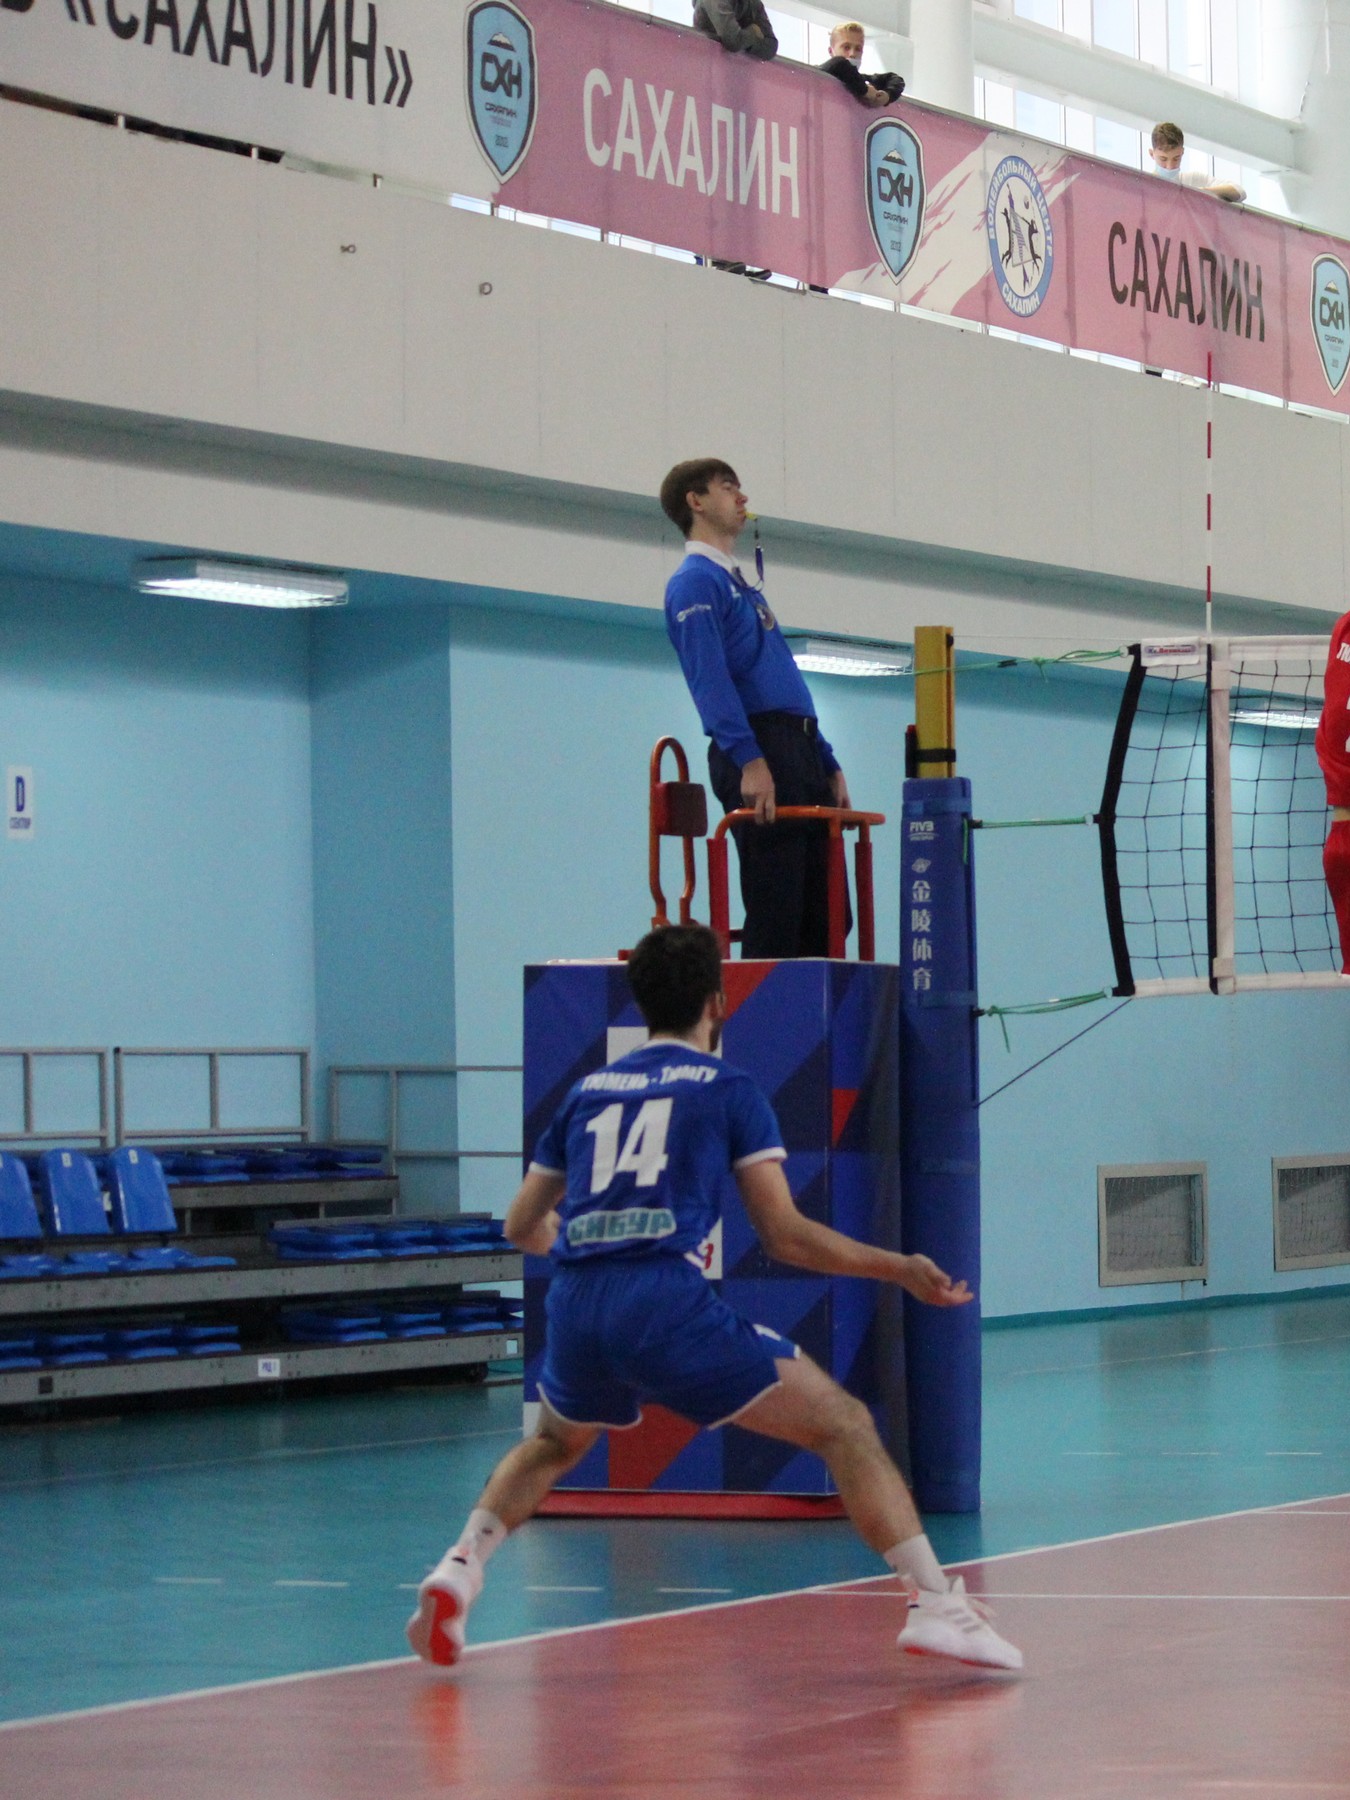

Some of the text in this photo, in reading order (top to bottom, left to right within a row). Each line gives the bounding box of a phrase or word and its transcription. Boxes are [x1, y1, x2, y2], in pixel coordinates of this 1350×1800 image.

[583, 67, 800, 219] САХАЛИН
[1002, 282, 1041, 315] САХАЛИН
[1108, 221, 1265, 343] САХАЛИН
[911, 879, 933, 991] 金陵体育
[585, 1098, 674, 1194] 14
[567, 1207, 678, 1247] СИБУР
